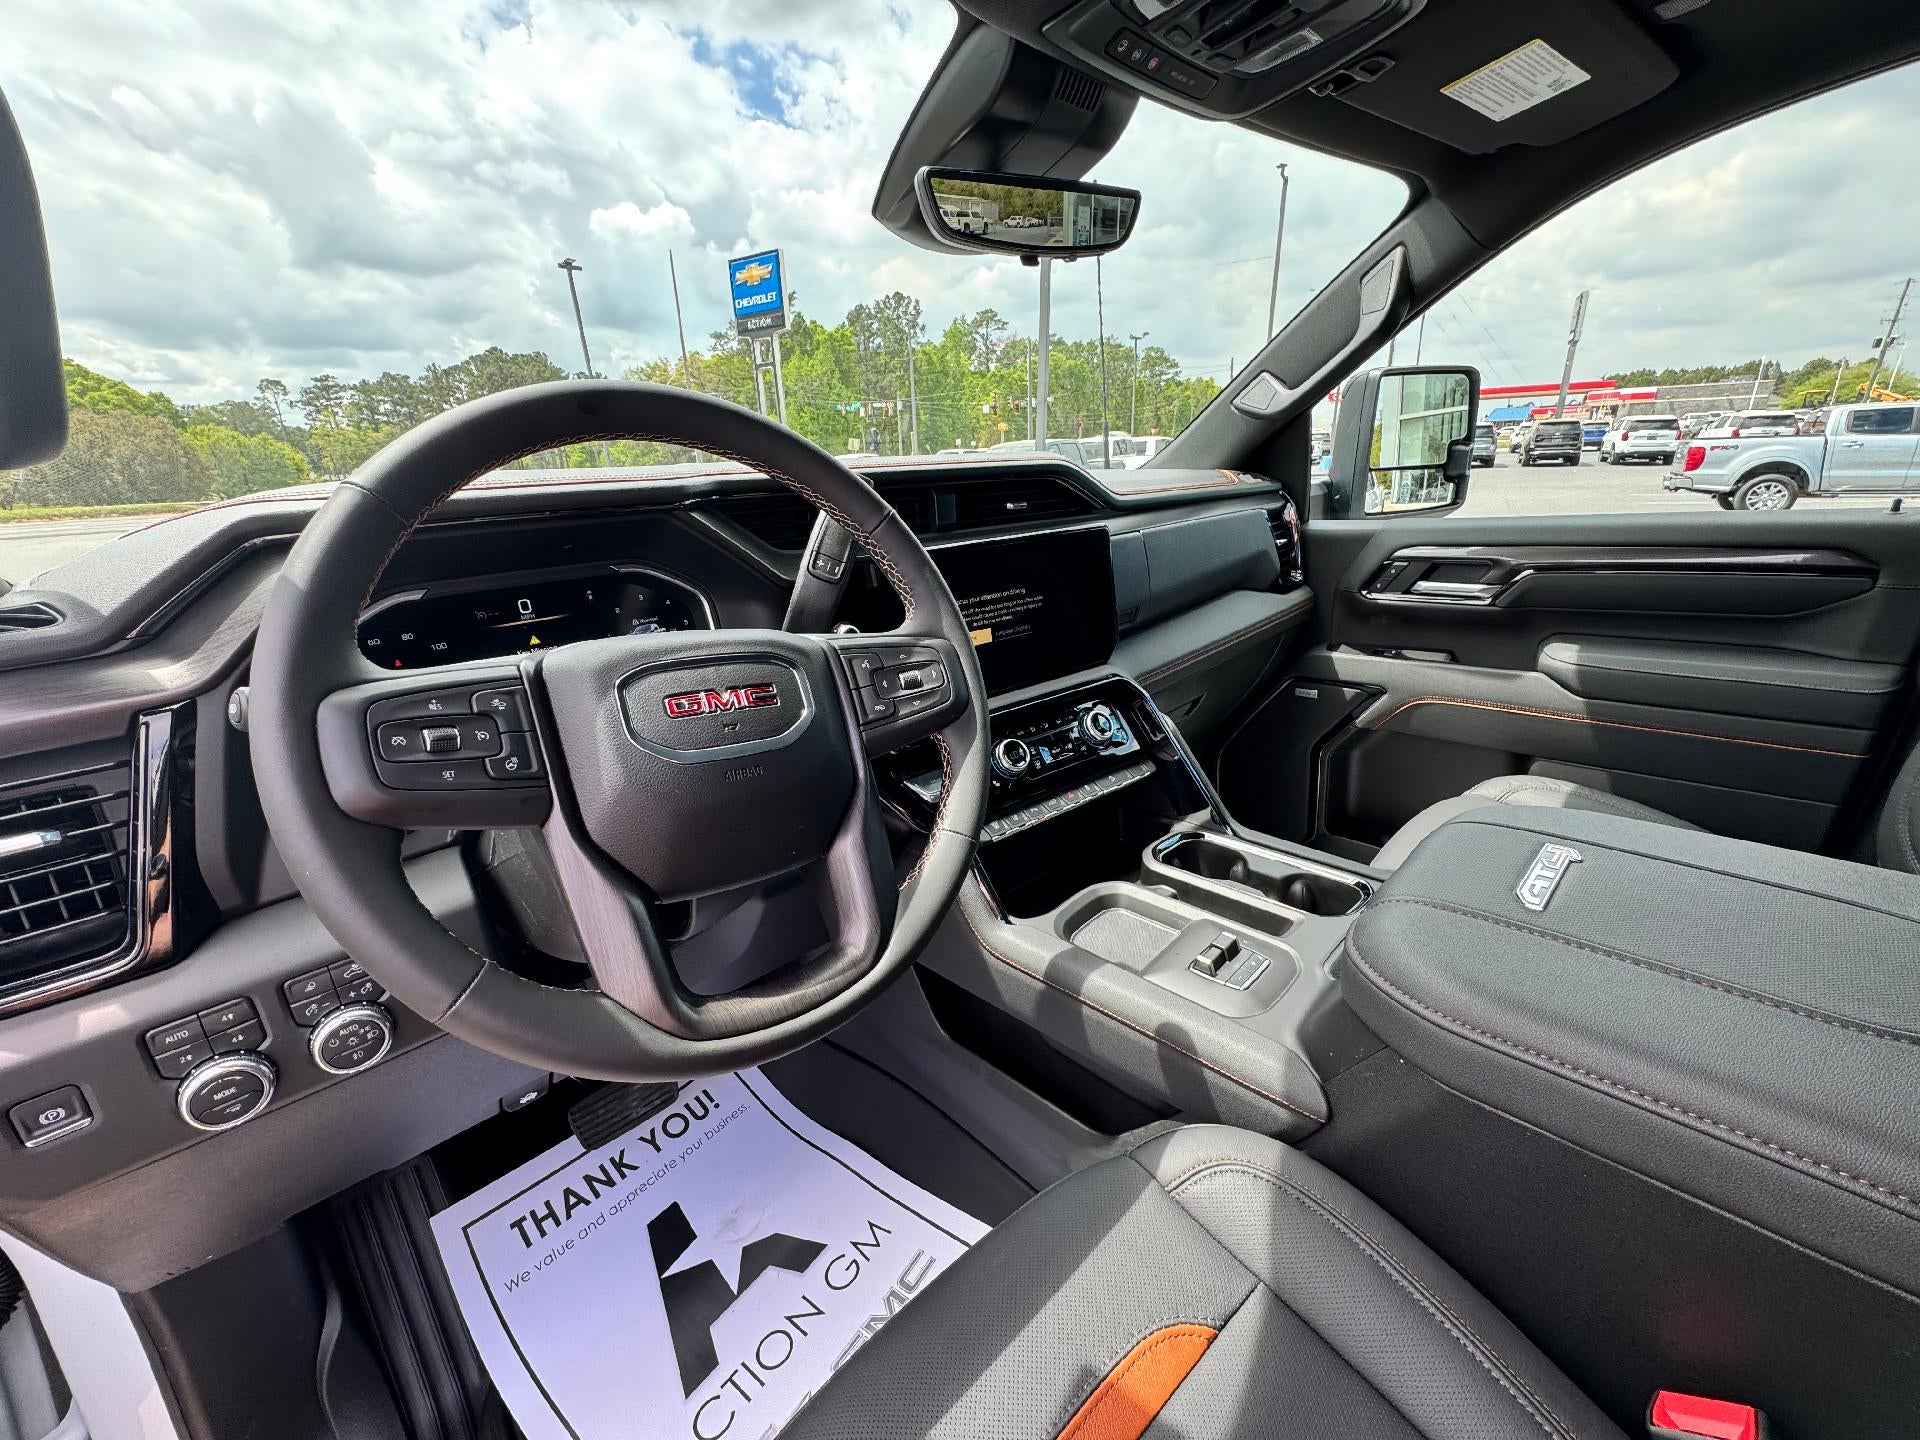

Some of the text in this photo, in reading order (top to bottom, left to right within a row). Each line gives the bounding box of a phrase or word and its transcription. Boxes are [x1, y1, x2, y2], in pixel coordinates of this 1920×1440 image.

[736, 291, 777, 309] CHEVROLET
[517, 598, 532, 614] 0
[664, 683, 781, 720] GMC
[442, 770, 455, 778] SET
[724, 764, 764, 783] AIRBAG
[165, 1030, 189, 1044] AUTO
[339, 1024, 359, 1036] AUTO
[213, 1086, 237, 1101] MODE
[510, 1088, 720, 1249] THANK YOU!
[504, 1102, 751, 1293] We value and appreciate your business.
[824, 1219, 893, 1291] GM
